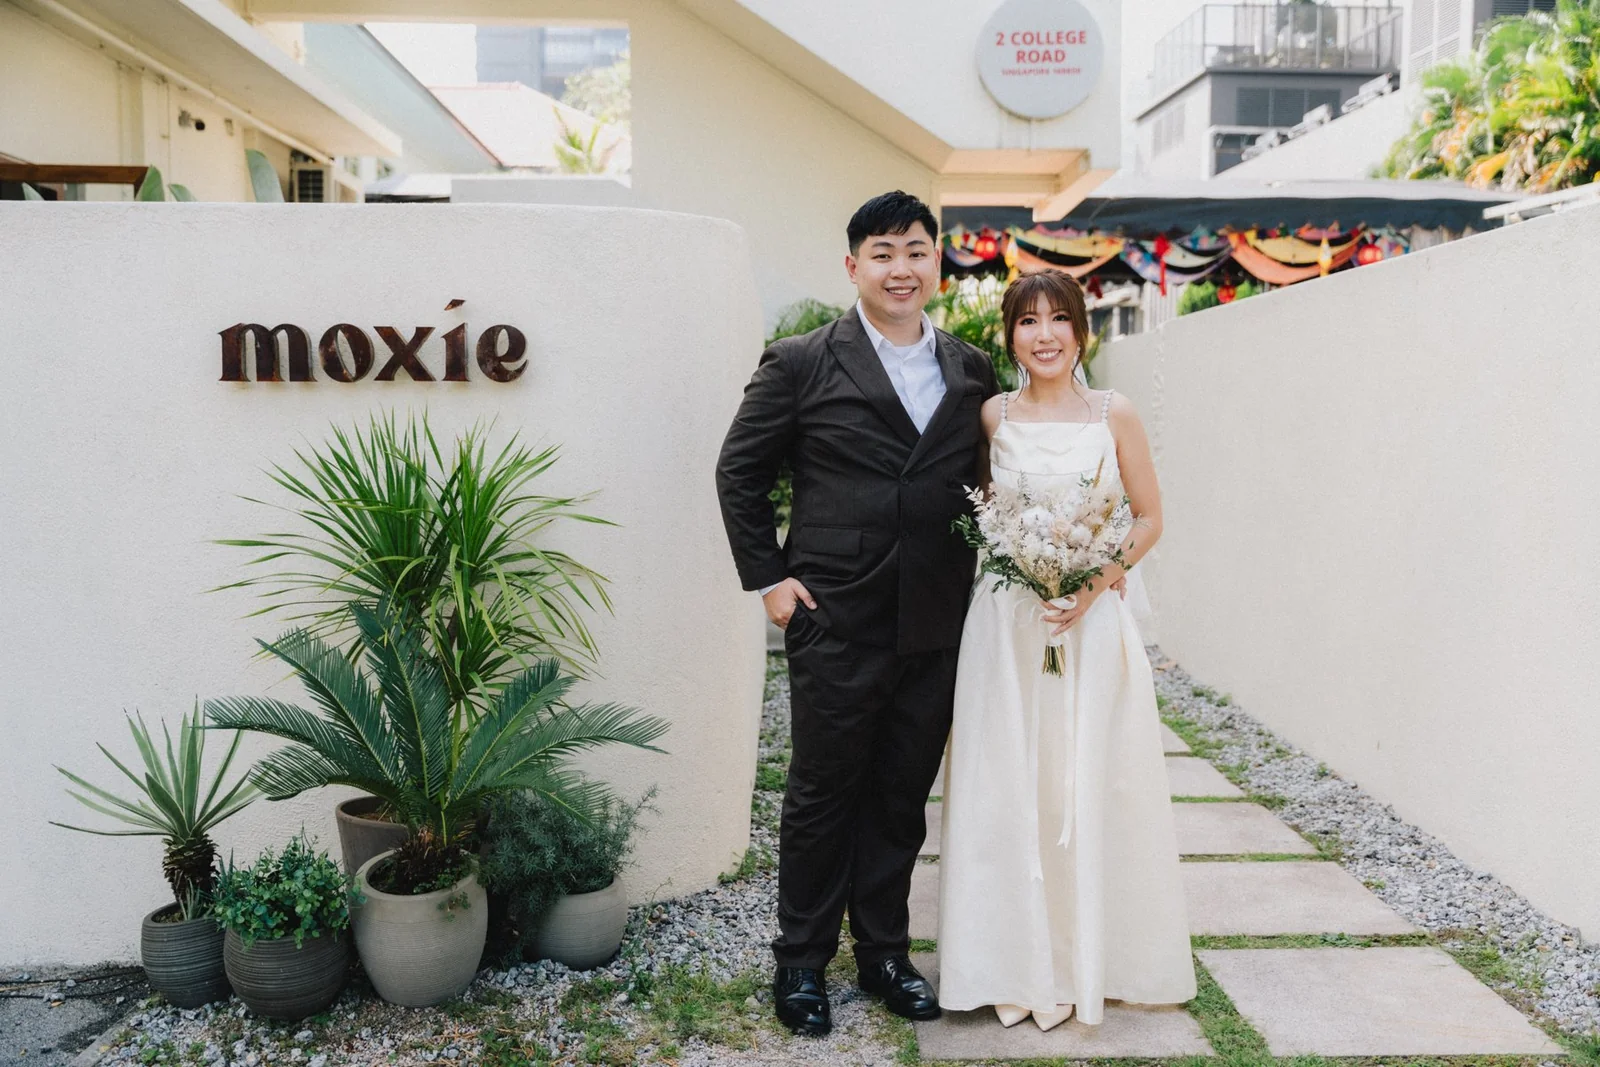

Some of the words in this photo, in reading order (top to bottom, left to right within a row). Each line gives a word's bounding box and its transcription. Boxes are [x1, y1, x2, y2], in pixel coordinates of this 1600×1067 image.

[995, 31, 1005, 46] 2
[1010, 30, 1087, 46] COLLEGE
[1016, 49, 1066, 63] ROAD
